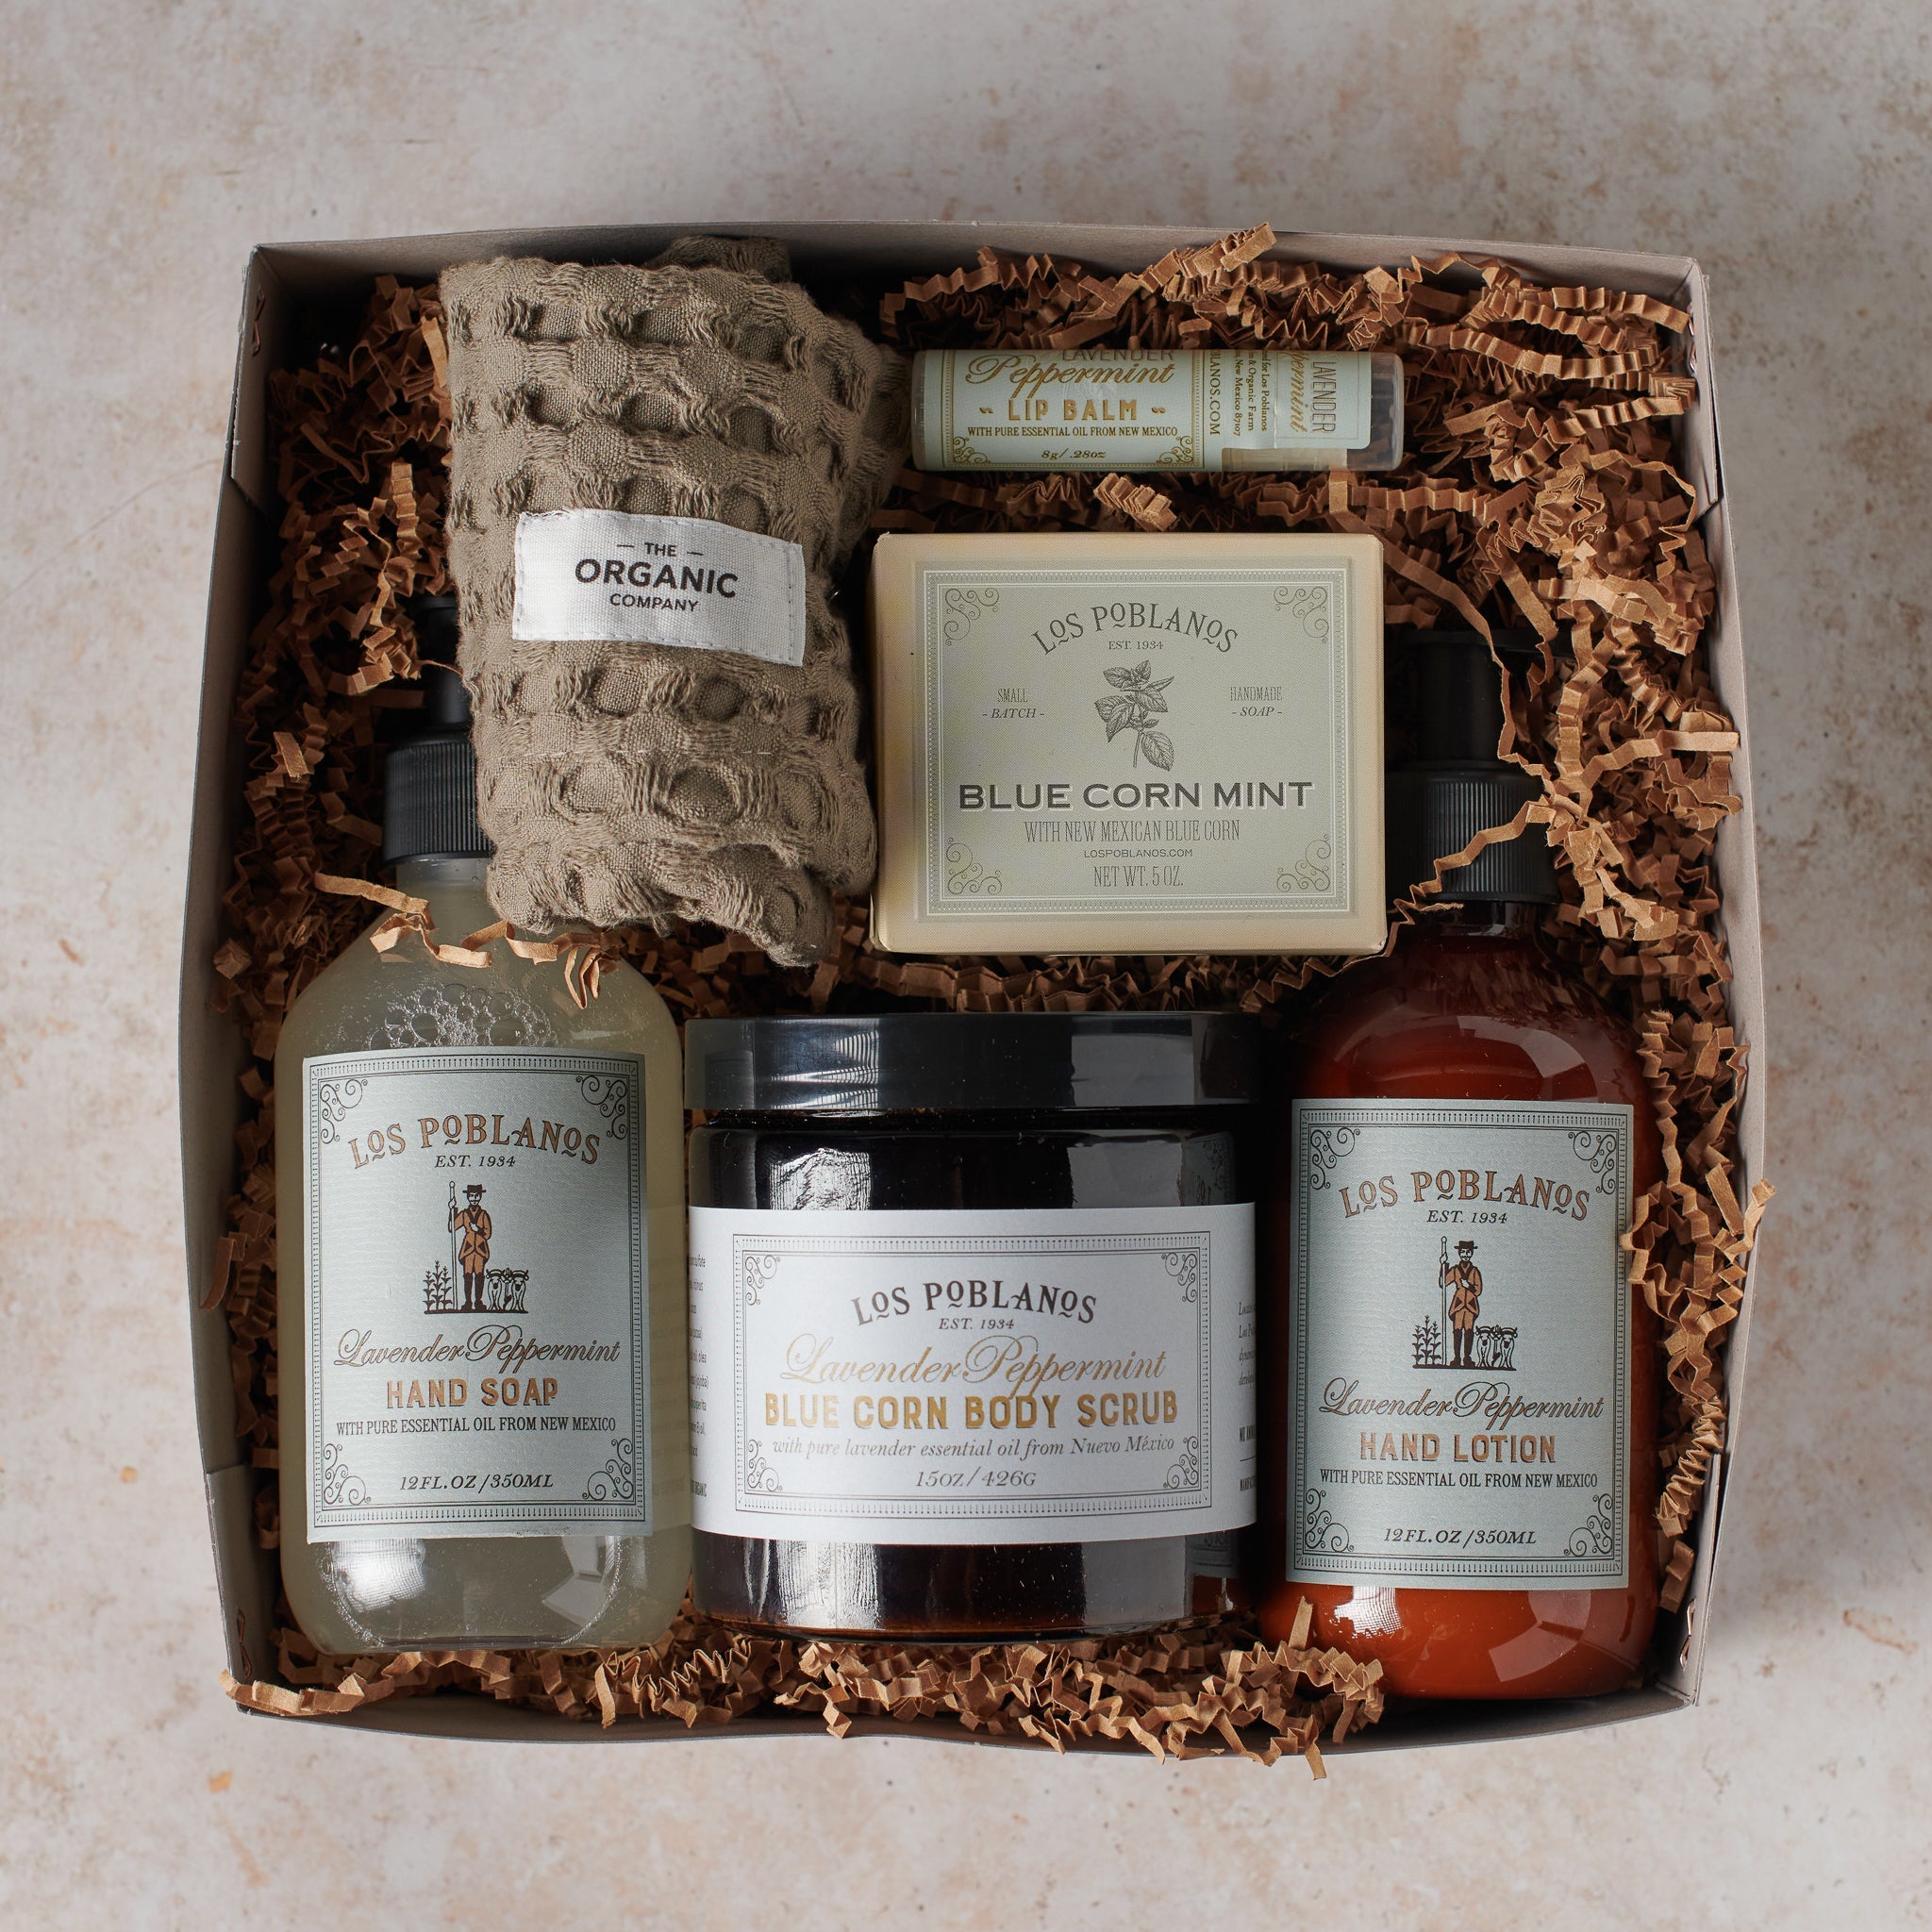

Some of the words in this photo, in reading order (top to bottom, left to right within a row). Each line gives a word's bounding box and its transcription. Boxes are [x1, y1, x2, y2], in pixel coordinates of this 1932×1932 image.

[965, 355, 1175, 399] Peppermint
[1235, 359, 1243, 375] New
[1235, 377, 1243, 410] Mexico
[1245, 368, 1257, 403] Organic
[1261, 375, 1271, 388] Los
[1310, 361, 1337, 433] LAVENDER
[1008, 399, 1049, 421] LIP
[1064, 399, 1138, 421] BALM
[1248, 406, 1257, 431] Farm
[1261, 391, 1272, 432] Poblanos
[968, 426, 992, 437] WITH
[994, 426, 1020, 437] PURE
[1022, 426, 1070, 437] ESSENTIAL
[1073, 426, 1088, 437] OIL
[1090, 426, 1116, 437] FROM
[1119, 426, 1140, 437] NEW
[1141, 426, 1178, 437] MEXICO
[1233, 412, 1243, 437] 87107
[644, 541, 677, 558] THE
[575, 558, 739, 598] ORGANIC
[609, 593, 699, 612] COMPANY
[1031, 612, 1085, 656] LOS
[1090, 602, 1240, 653] POBLANOS
[1108, 641, 1132, 650] EST.
[1136, 641, 1165, 650] 1934
[997, 688, 1029, 703] SMALL
[1229, 686, 1283, 702] HANDMADE
[958, 783, 1074, 811] BLUE
[1082, 782, 1203, 809] CORN
[1213, 781, 1314, 808] MINT
[1024, 821, 1061, 842] WITH
[1064, 821, 1097, 842] NEW
[1100, 820, 1162, 841] MEXICAN
[1164, 820, 1201, 841] BLUE
[1204, 819, 1241, 841] CORN
[1083, 849, 1194, 858] LOSPOBLANOS.COM
[1093, 865, 1120, 888] NET
[1124, 865, 1149, 888] WT.
[1152, 865, 1160, 888] 5
[1163, 865, 1184, 888] OZ.
[348, 1122, 407, 1170] LOS
[417, 1113, 601, 1165] POBLANOS
[434, 1154, 472, 1168] EST.
[477, 1154, 516, 1168] 1934
[1339, 1174, 1399, 1219] LOS
[1410, 1169, 1591, 1221] POBLANOS
[1426, 1209, 1463, 1224] EST.
[1470, 1211, 1508, 1224] 1934
[851, 1285, 911, 1325] LOS
[922, 1279, 1098, 1324] POBLANOS
[938, 1318, 974, 1330] EST.
[979, 1318, 1015, 1330] 1934
[333, 1327, 466, 1368] Lavender
[465, 1324, 622, 1374] Peppermint
[779, 1332, 962, 1385] Lavender
[962, 1334, 1167, 1401] Peppermint
[386, 1377, 468, 1409] HAND
[480, 1377, 559, 1407] SOAP
[1318, 1376, 1454, 1417] Lavender
[1453, 1381, 1605, 1431] Peppermint
[765, 1391, 840, 1428] BLUE
[853, 1395, 949, 1430] CORN
[964, 1394, 1060, 1430] BODY
[1076, 1390, 1178, 1427] SCRUB
[336, 1421, 364, 1436] WITH
[367, 1420, 398, 1435] PURE
[401, 1418, 470, 1434] ESSENTIAL
[473, 1417, 496, 1431] OIL
[499, 1417, 538, 1431] FROM
[540, 1416, 570, 1431] NEW
[572, 1417, 616, 1431] MEXICO
[773, 1437, 803, 1455] with
[806, 1440, 840, 1460] pure
[844, 1439, 917, 1457] lavender
[920, 1439, 991, 1457] essential
[997, 1437, 1020, 1456] oil
[1021, 1438, 1064, 1461] from
[1071, 1436, 1121, 1455] Nuevo
[1124, 1433, 1174, 1453] México
[1359, 1431, 1441, 1461] HAND
[1454, 1434, 1557, 1463] LOTION
[1320, 1468, 1348, 1485] WITH
[1351, 1471, 1384, 1486] PURE
[1386, 1472, 1457, 1487] ESSENTIAL
[1458, 1473, 1481, 1488] OIL
[1485, 1473, 1523, 1488] FROM
[1524, 1473, 1554, 1488] NEW
[1556, 1473, 1598, 1488] MEXICO
